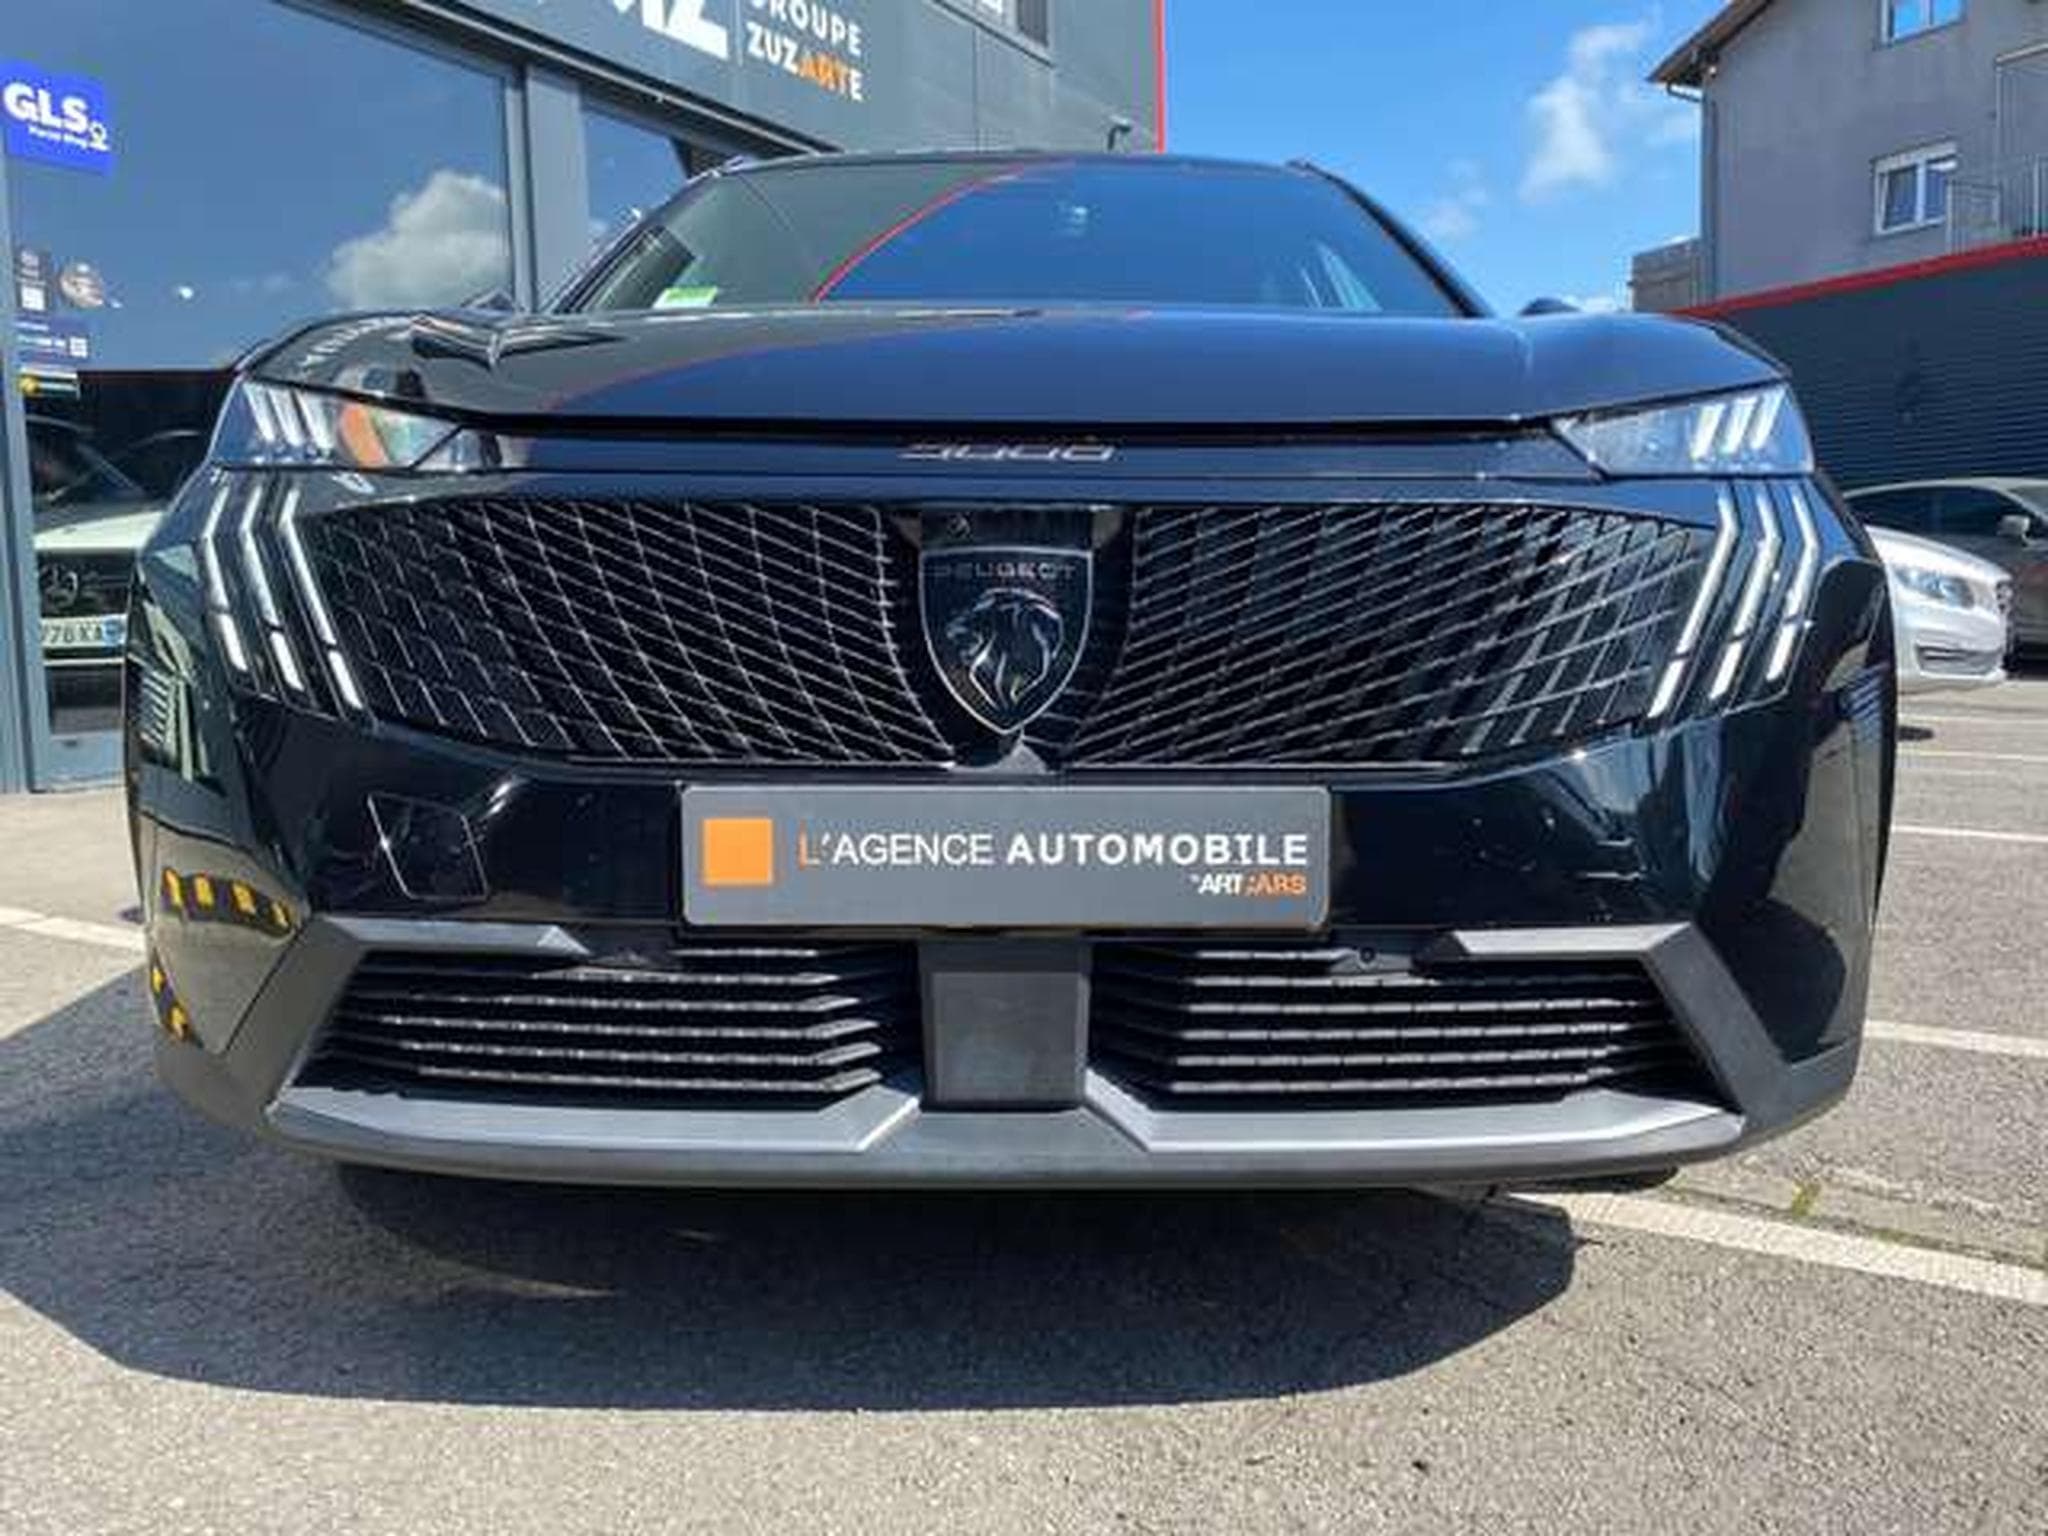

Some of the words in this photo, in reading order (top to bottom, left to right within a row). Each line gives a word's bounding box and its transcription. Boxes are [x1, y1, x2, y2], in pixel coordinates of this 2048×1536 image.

[752, 0, 862, 58] ROUPE
[746, 21, 863, 101] ZUZARTE
[3, 82, 88, 133] GLS
[798, 833, 994, 866] L'AGENCE
[1006, 833, 1308, 866] AUTOMOBILE
